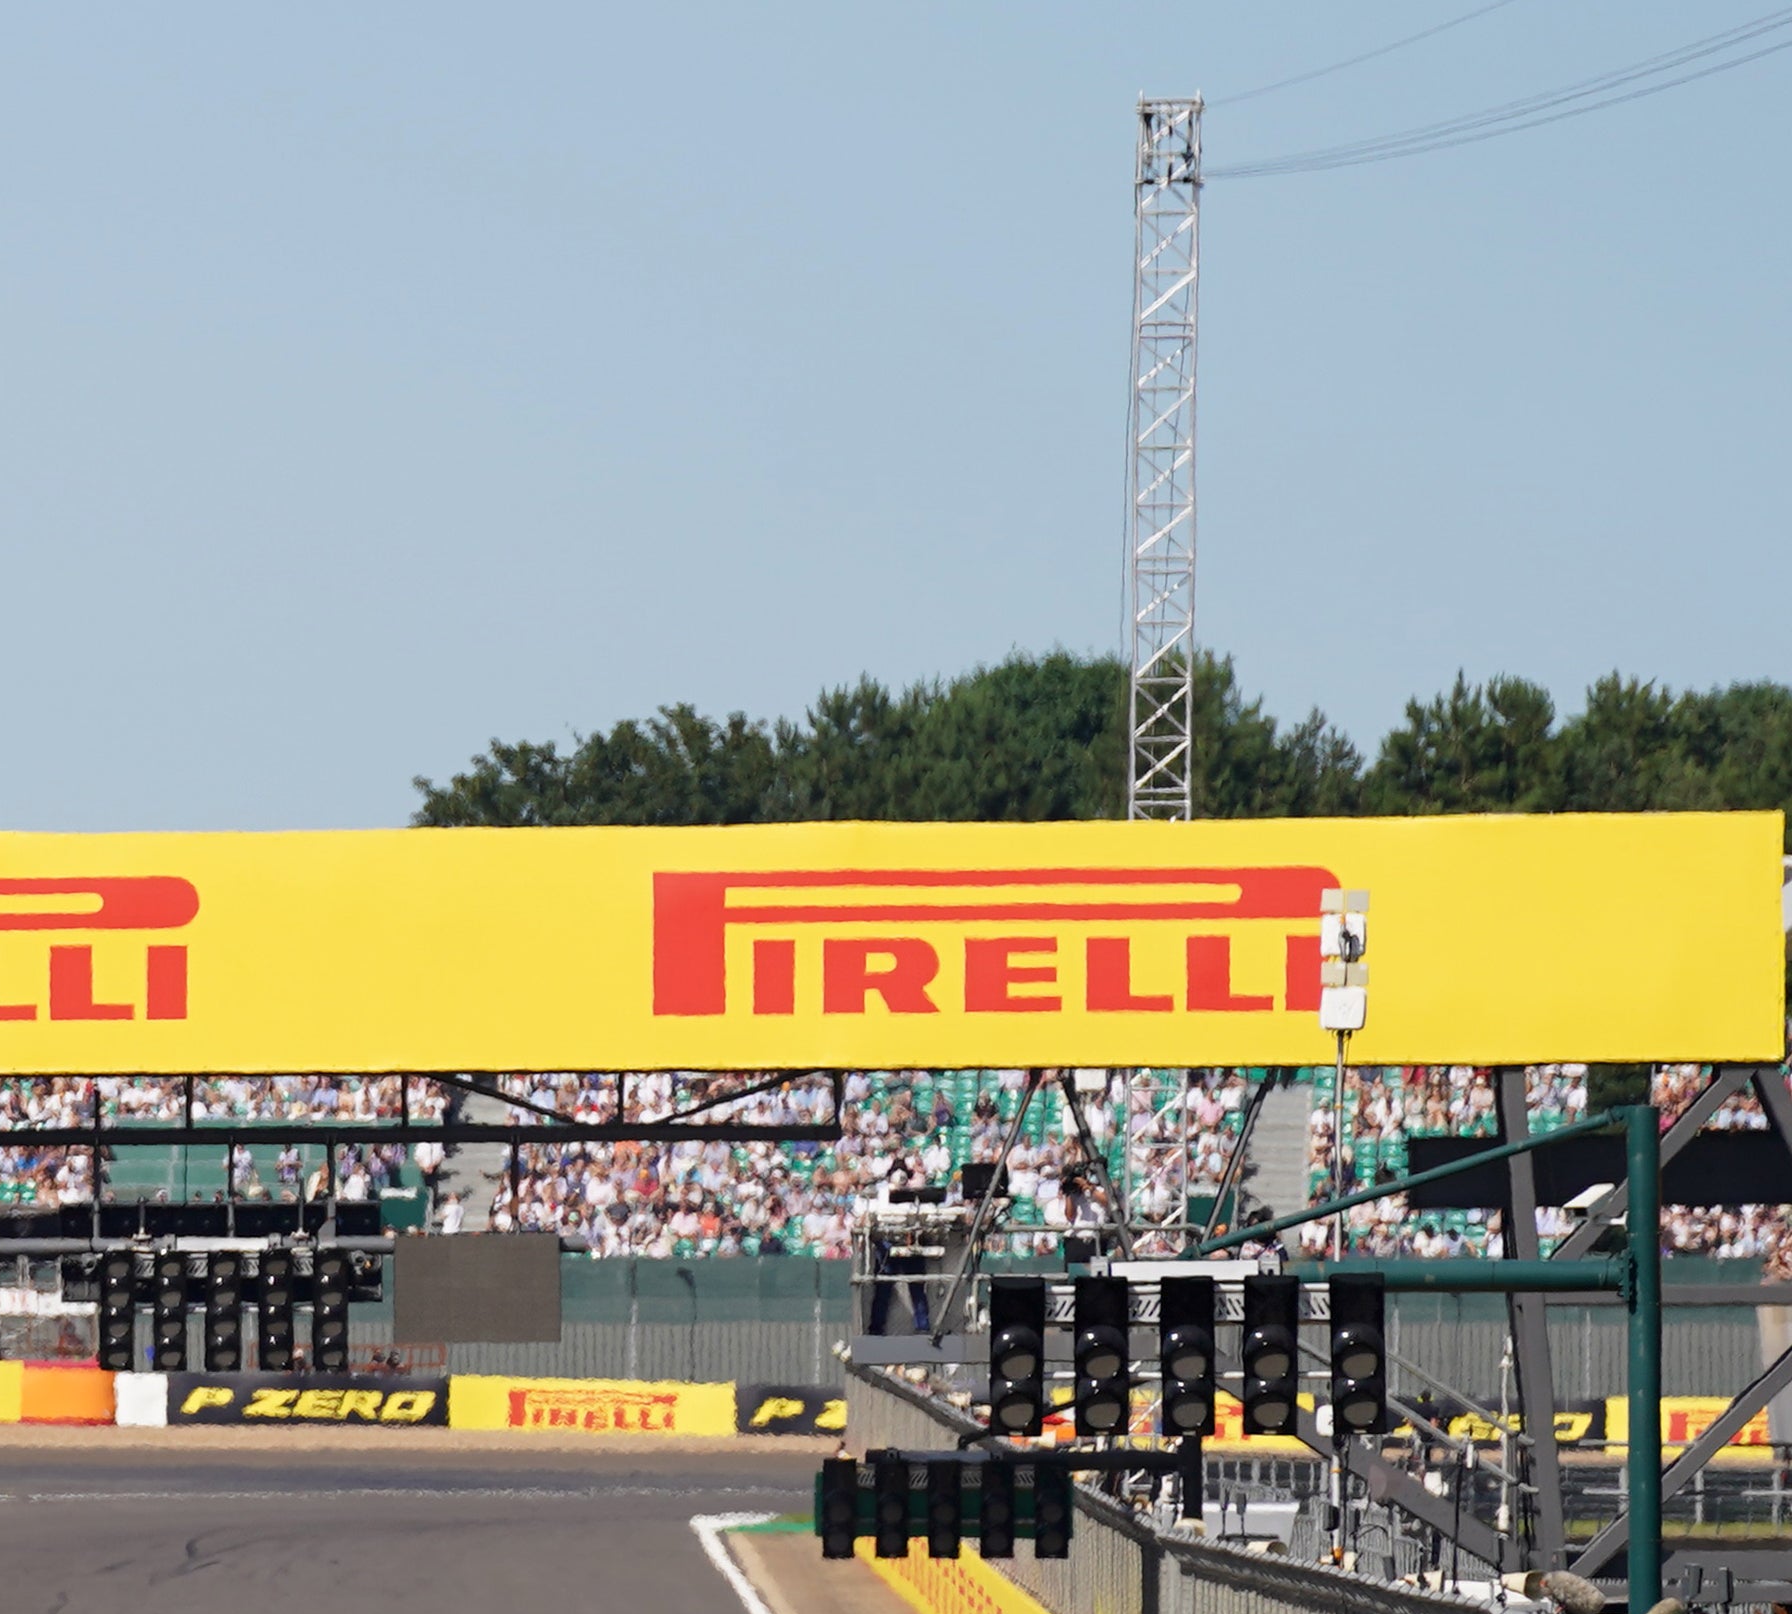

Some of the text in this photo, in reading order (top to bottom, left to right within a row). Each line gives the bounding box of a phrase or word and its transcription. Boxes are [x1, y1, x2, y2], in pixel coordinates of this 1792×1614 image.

[652, 865, 1344, 1018] PIRELLI
[180, 1387, 437, 1421] P ZERO
[509, 1388, 676, 1429] PIRELLI
[747, 1397, 804, 1427] P
